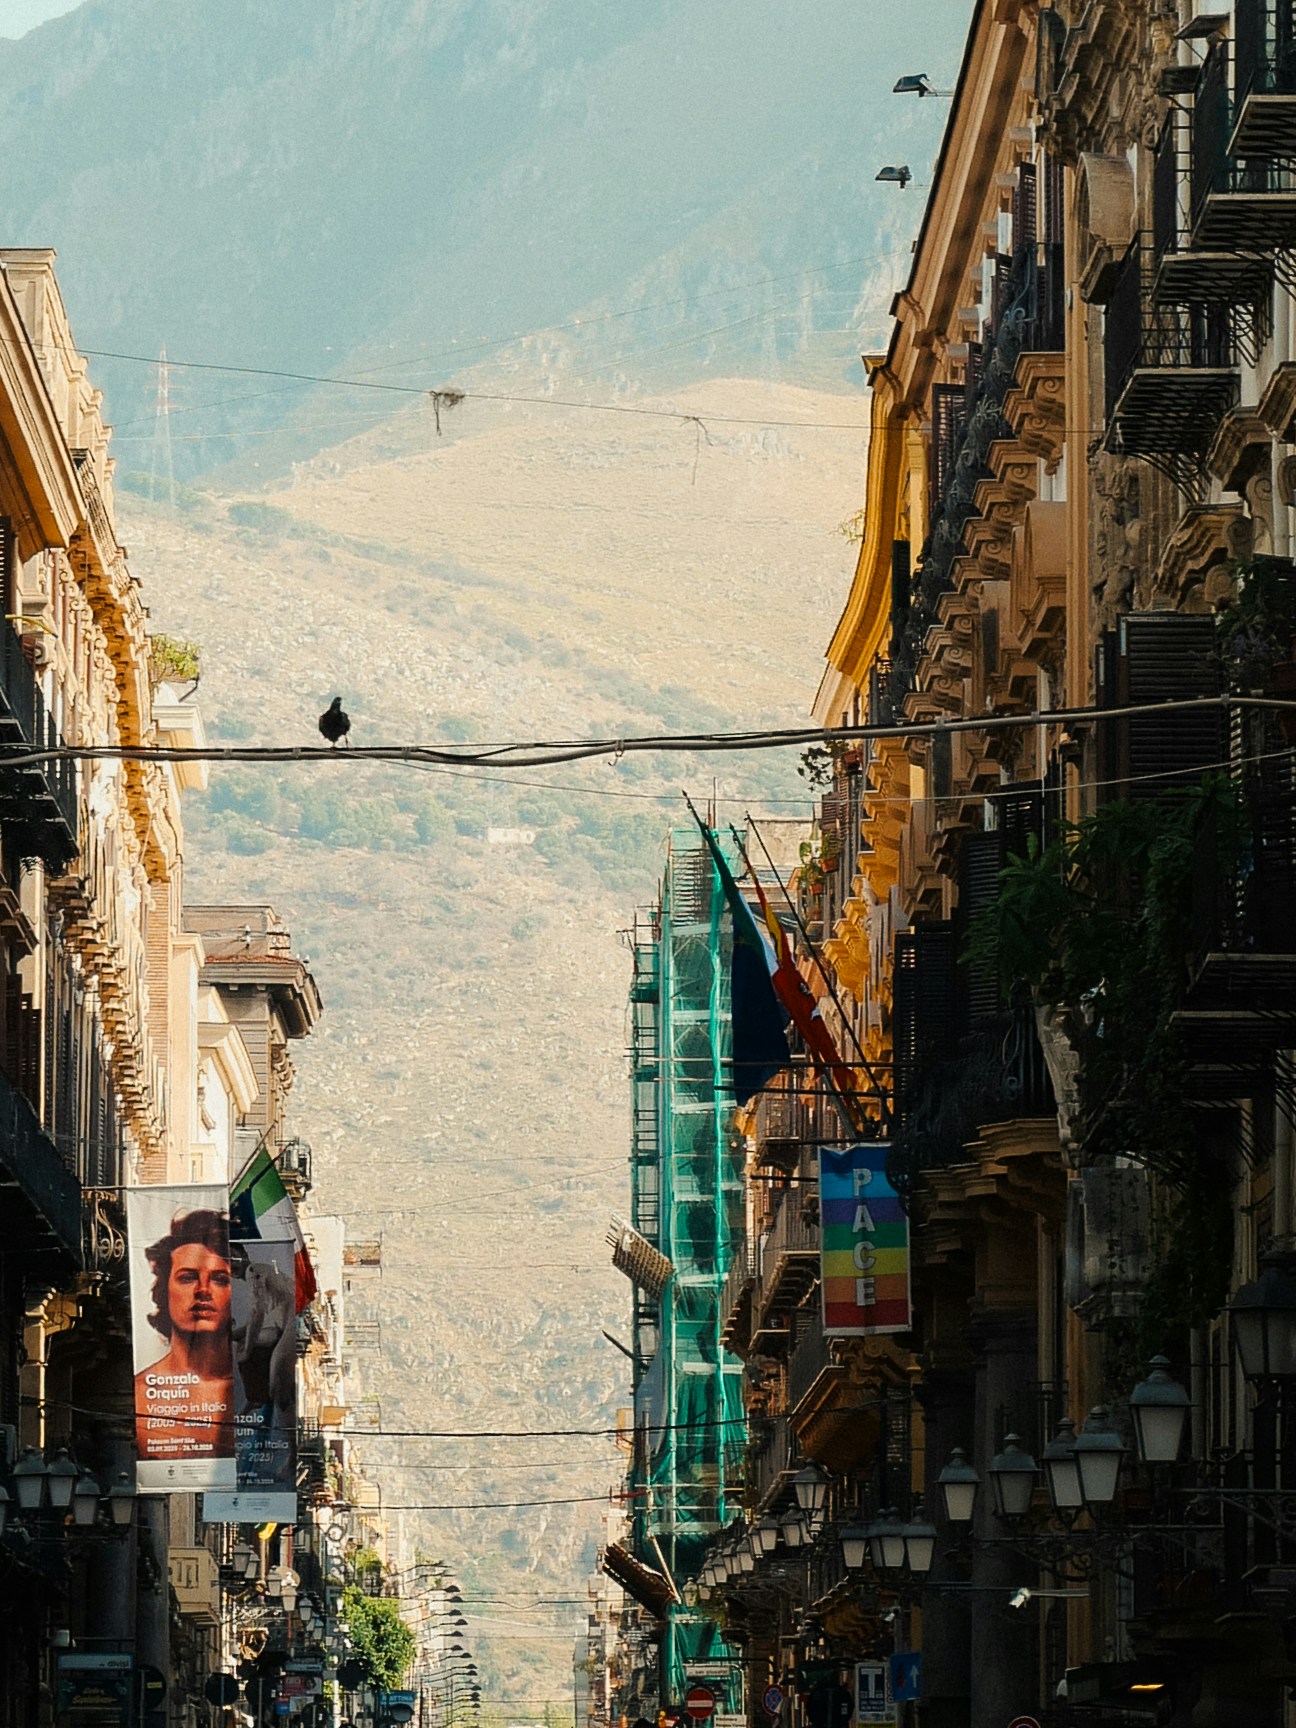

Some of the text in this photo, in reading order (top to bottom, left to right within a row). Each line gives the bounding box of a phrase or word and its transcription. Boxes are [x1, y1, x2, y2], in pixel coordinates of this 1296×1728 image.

[852, 1167, 877, 1306] PACE
[145, 1373, 200, 1386] Gonzalo
[145, 1385, 190, 1401] Orquín
[146, 1401, 227, 1415] Viaggio in Italia
[265, 1439, 288, 1450] Italia
